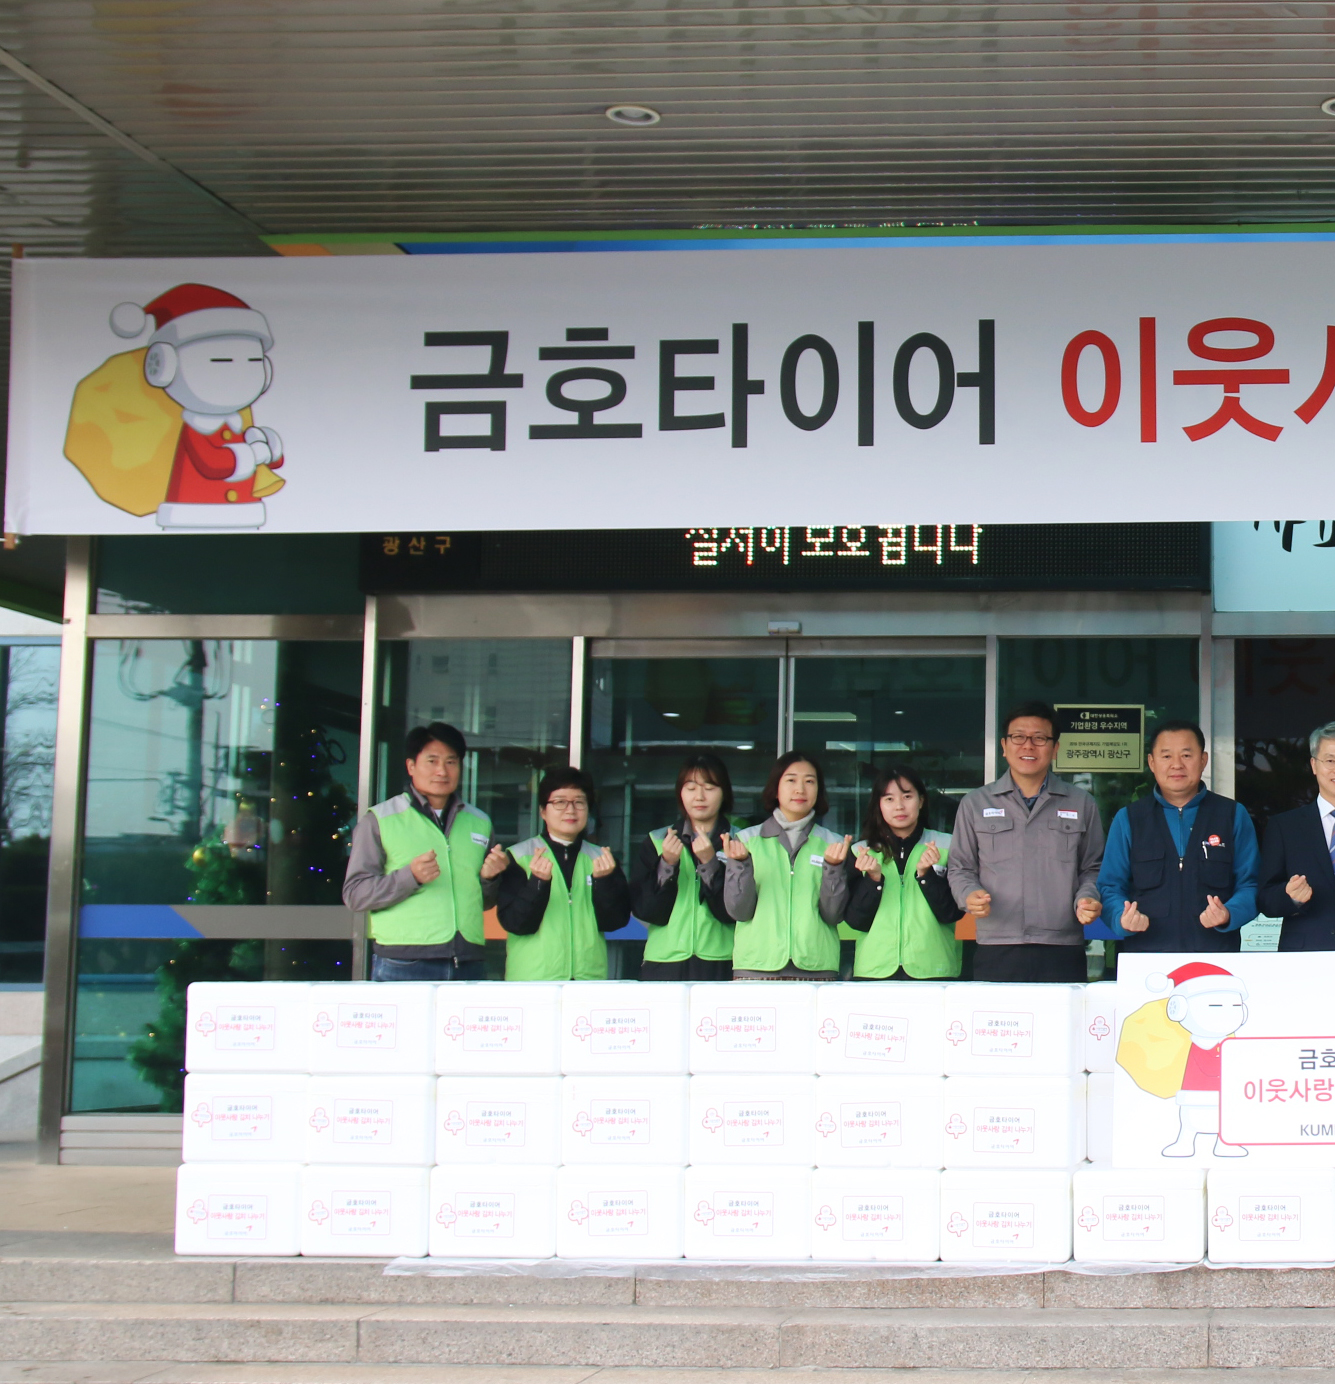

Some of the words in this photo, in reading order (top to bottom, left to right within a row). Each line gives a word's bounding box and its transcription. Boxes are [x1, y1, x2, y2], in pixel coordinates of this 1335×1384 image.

[410, 319, 996, 452] 금호타이어
[382, 534, 452, 556] 광산구
[1070, 722, 1098, 730] 기업환경
[1100, 722, 1128, 730] 우수지역
[1066, 750, 1105, 759] 광주광역시
[1107, 750, 1131, 759] 광산구
[353, 1012, 383, 1020] 금호타이어
[862, 1022, 894, 1032] 금호타이어
[987, 1019, 1019, 1028] 금호타이어
[1243, 1077, 1335, 1103] 이웃사랑
[348, 1108, 378, 1116] 금호타이어
[481, 1110, 511, 1118] 금호타이어
[738, 1109, 769, 1117] 금호타이어
[855, 1110, 886, 1118] 금호타이어
[868, 1120, 880, 1128] 김치
[881, 1119, 899, 1127] 나누기
[989, 1115, 1021, 1124] 금호타이어
[728, 1199, 760, 1207] 금호타이어
[857, 1203, 889, 1211] 금호타이어
[1118, 1203, 1150, 1211] 금호타이어
[1254, 1204, 1286, 1212] 금호타이어
[482, 1210, 493, 1218] 김치
[495, 1210, 512, 1218] 나누기
[988, 1210, 1020, 1219] 금호타이어
